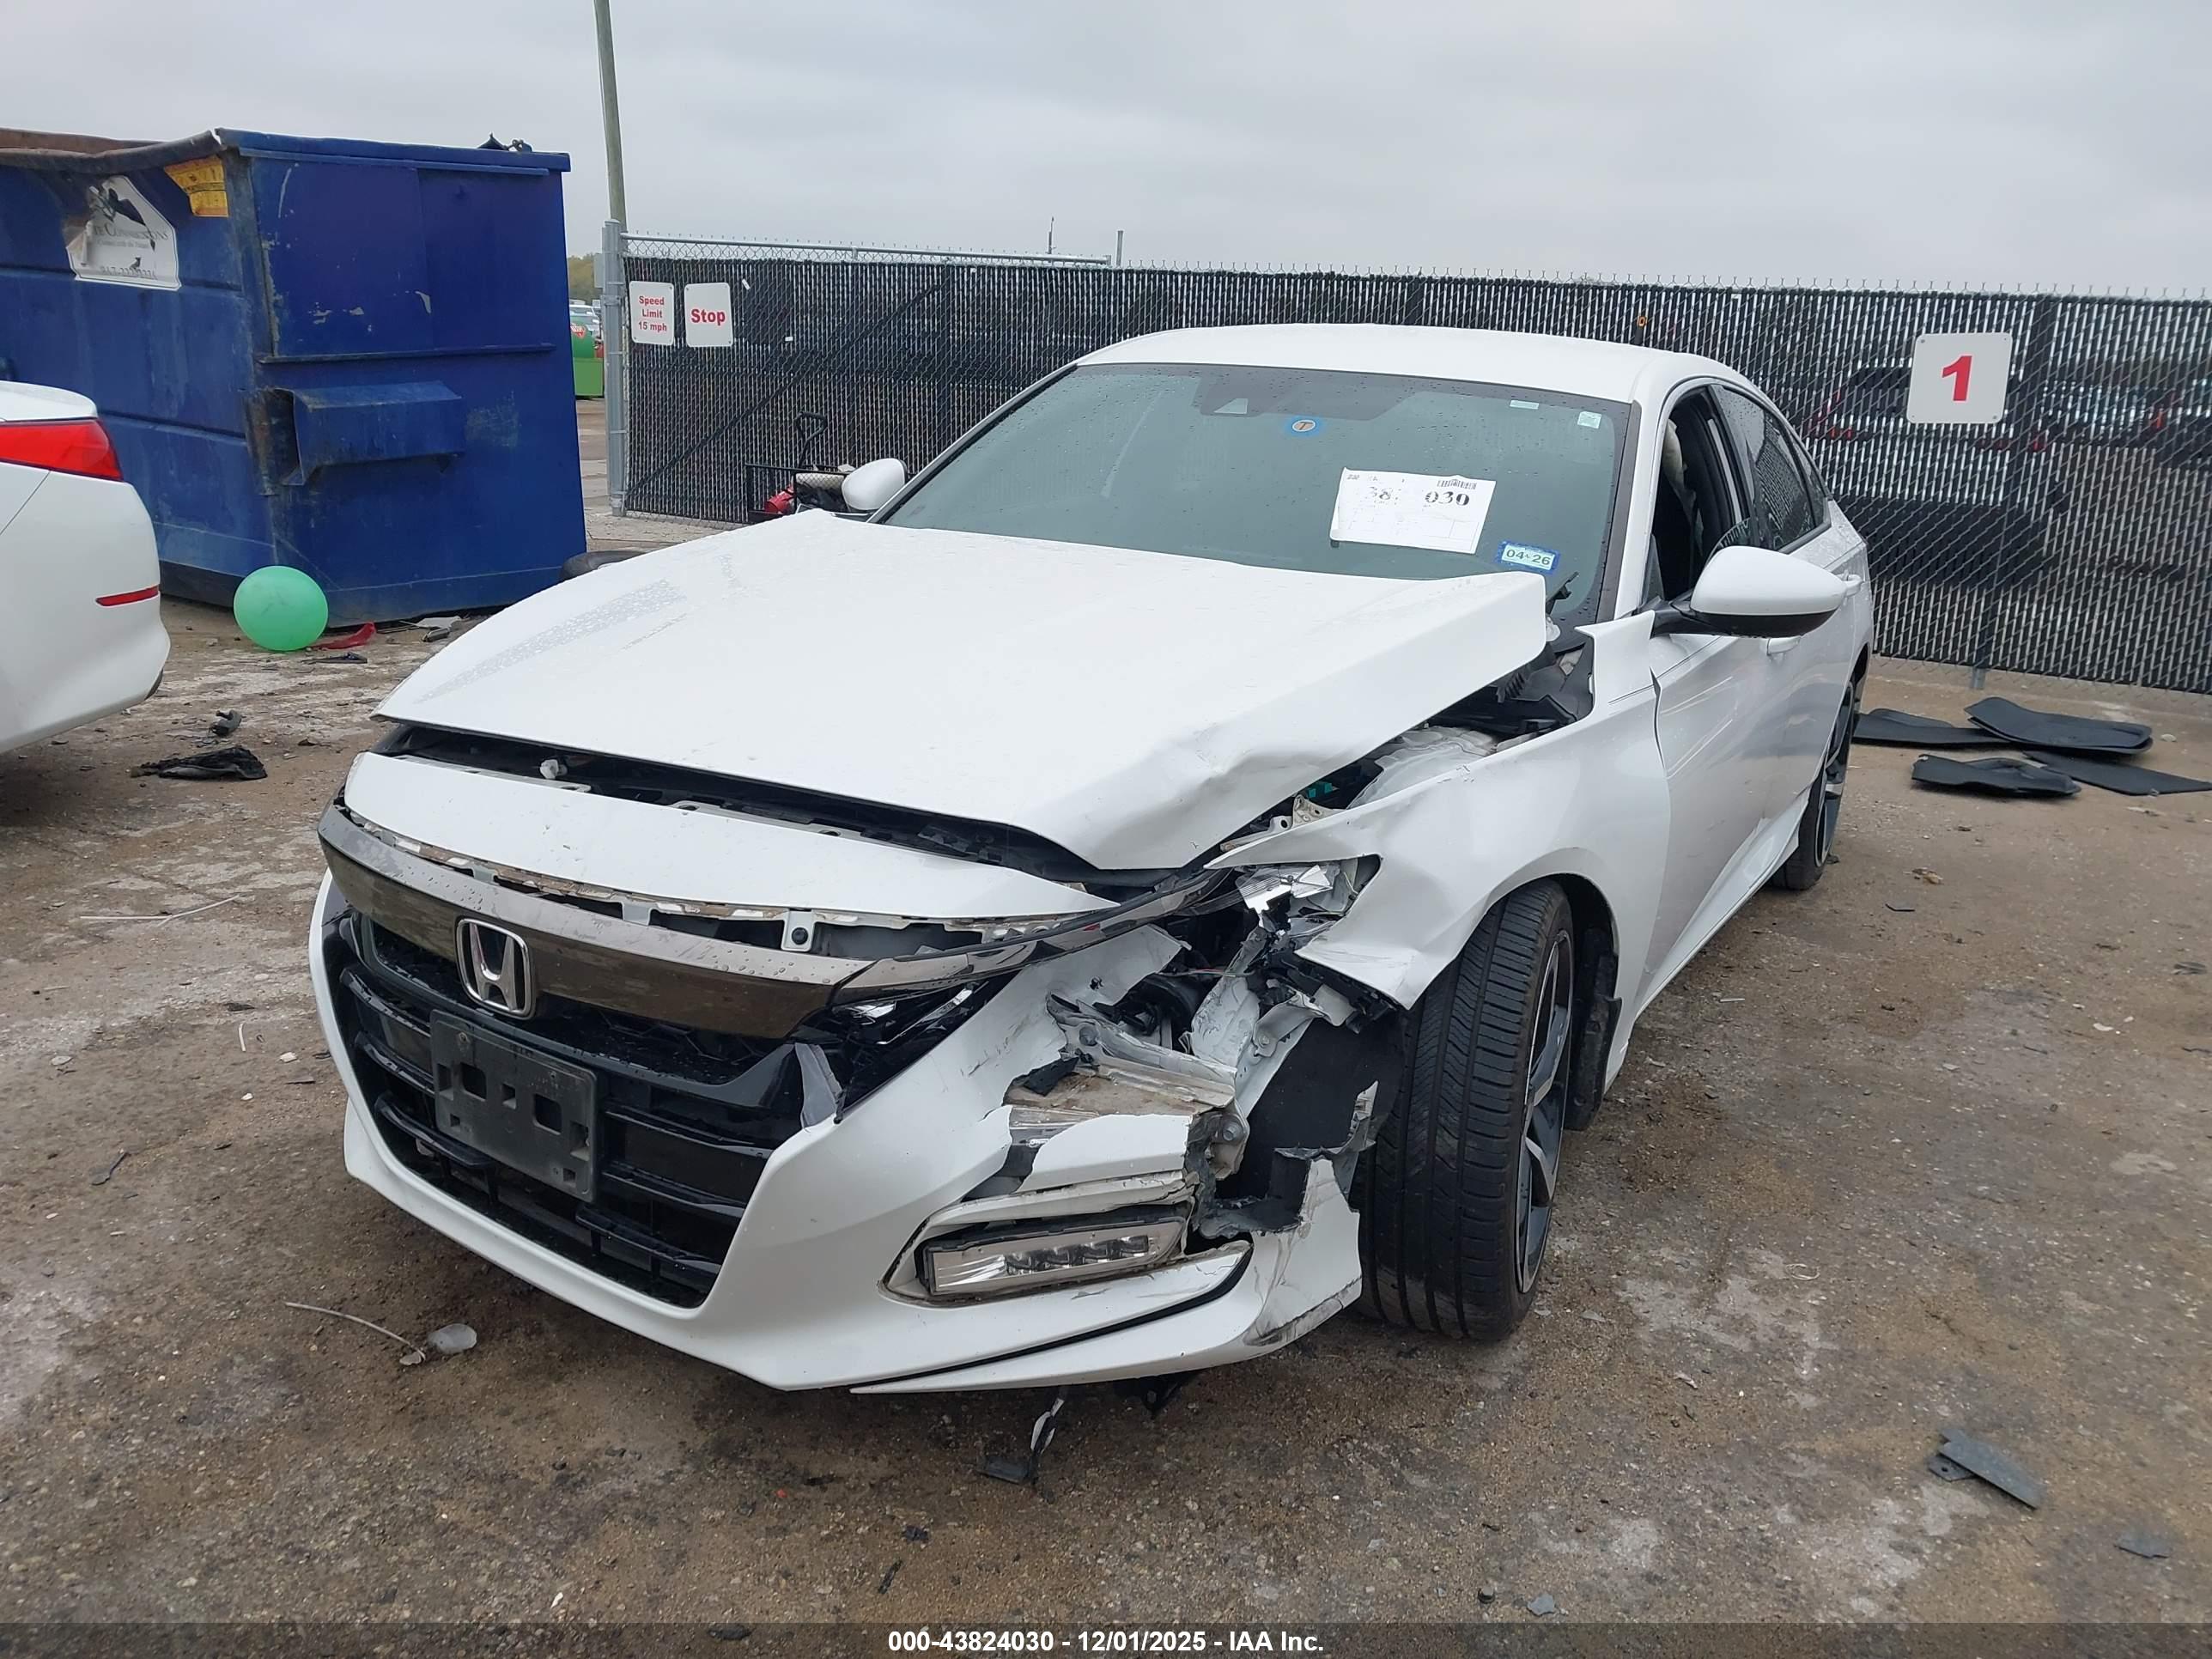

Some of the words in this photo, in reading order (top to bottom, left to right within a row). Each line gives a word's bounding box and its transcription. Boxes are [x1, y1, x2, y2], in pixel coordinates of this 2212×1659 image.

[639, 295, 665, 306] Speed
[641, 309, 663, 319] Limit
[690, 308, 726, 325] Stop
[638, 322, 648, 331] 15
[650, 323, 667, 333] mph
[1942, 355, 1972, 402] 1
[1425, 490, 1470, 507] 030
[1506, 549, 1525, 560] 04
[1532, 554, 1551, 566] 26
